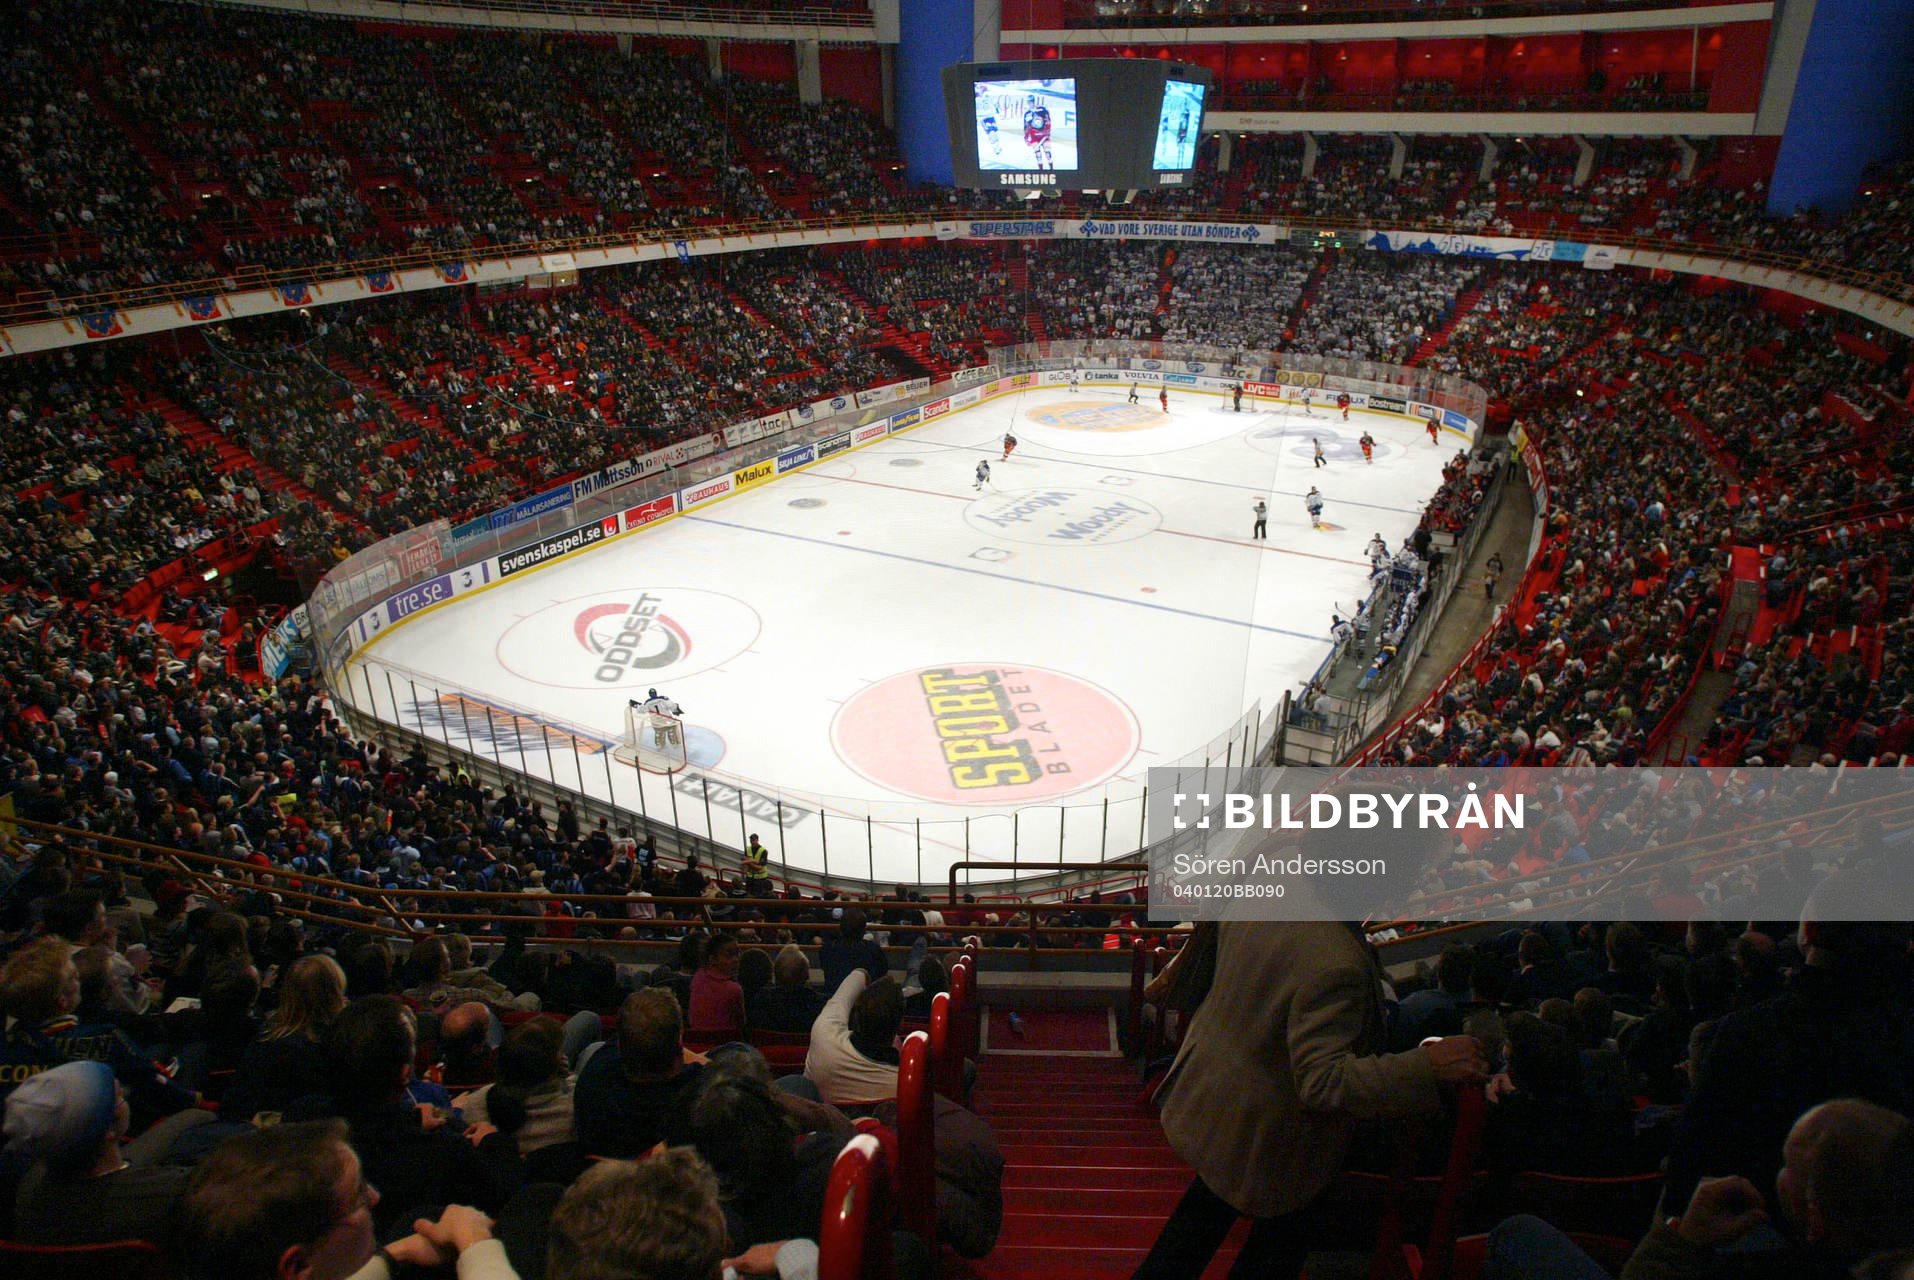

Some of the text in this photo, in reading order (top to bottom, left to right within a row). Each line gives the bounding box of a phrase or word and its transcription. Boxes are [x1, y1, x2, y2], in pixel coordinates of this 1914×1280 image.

[1000, 174, 1056, 185] SAMSUNG
[969, 221, 1055, 237] SUPERSTARS
[1099, 223, 1240, 238] VAD VORE SVERIGE UTAN BÖNDER
[1124, 371, 1159, 380] VOLVIA
[1244, 384, 1266, 395] JVC
[924, 400, 949, 417] Scandic
[653, 452, 674, 465] RIVAL
[574, 462, 644, 498] FM Mattsson
[735, 465, 772, 486] Malux
[692, 481, 729, 501] BAUHAUS
[516, 492, 571, 520] MÅLARSANERING
[1048, 502, 1149, 540] Woody
[501, 527, 601, 573] svenskaspel.se
[395, 581, 443, 616] tre.se
[594, 593, 662, 682] ODDSET
[919, 668, 1042, 789] SPORT
[1001, 668, 1072, 775] BLADET
